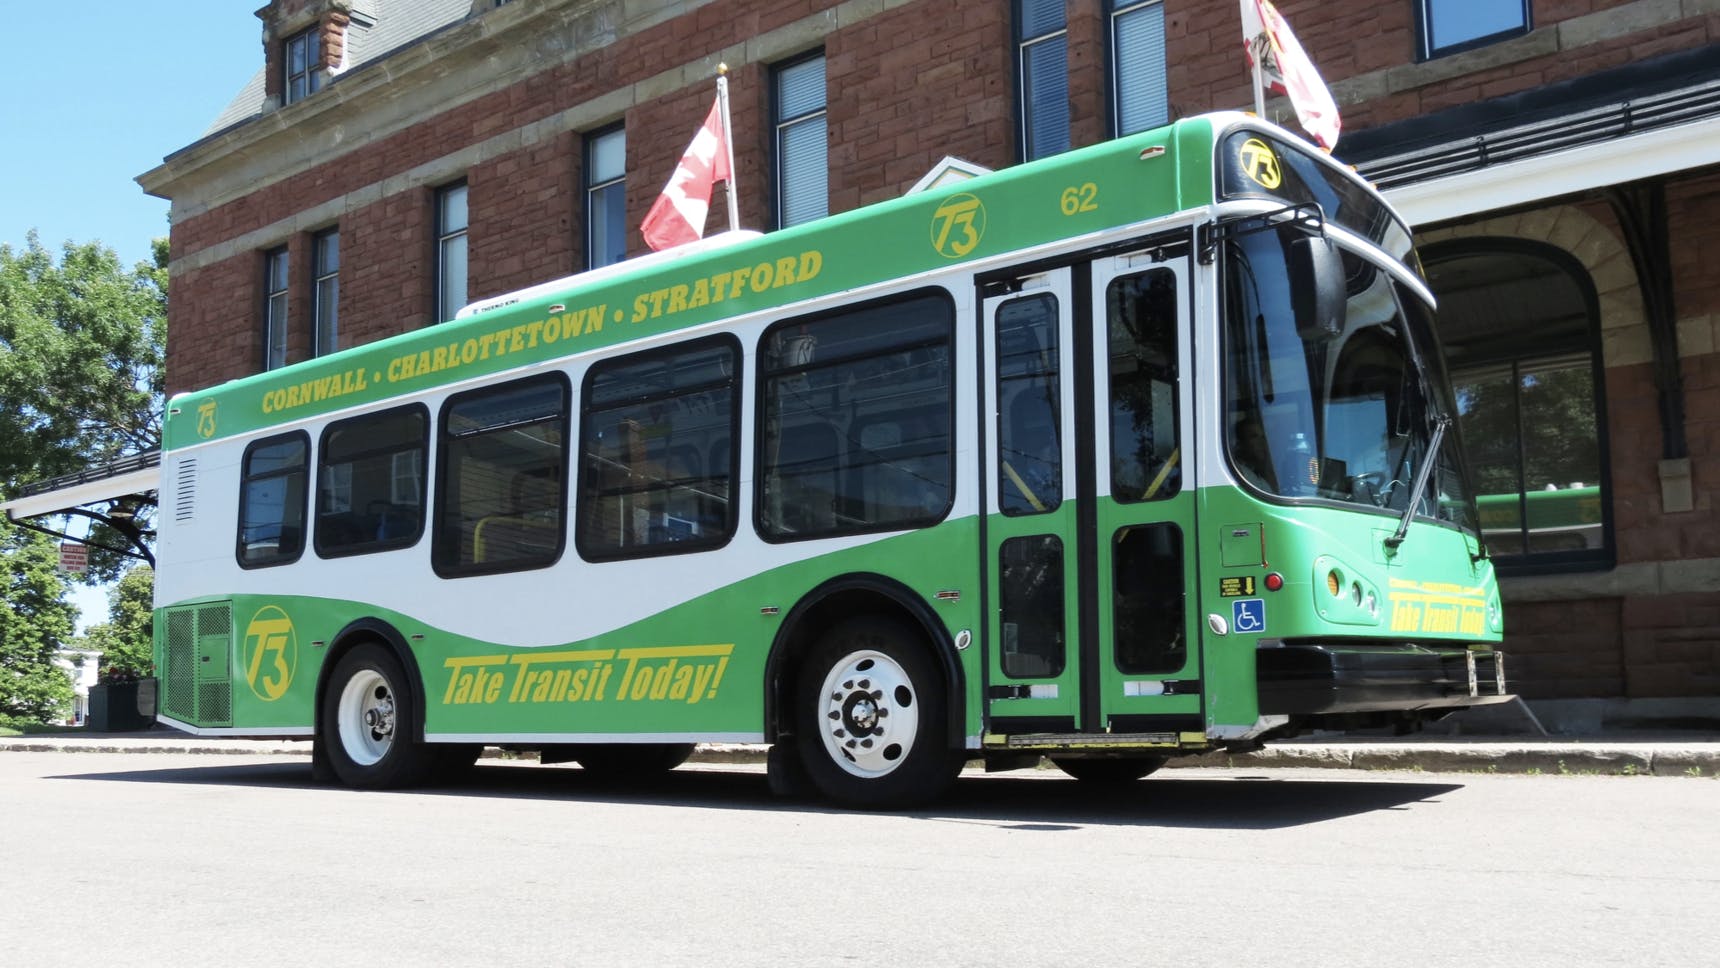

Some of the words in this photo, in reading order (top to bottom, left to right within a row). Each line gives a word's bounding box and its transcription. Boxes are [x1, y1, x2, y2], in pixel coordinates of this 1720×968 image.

[1060, 182, 1098, 216] 62
[262, 367, 368, 414] CORNWALL
[387, 304, 607, 383] CHARLOTTETOWN
[631, 250, 823, 324] STRATFORD
[443, 654, 508, 705] Take
[508, 649, 617, 703] Transit
[616, 643, 735, 705] Today!
